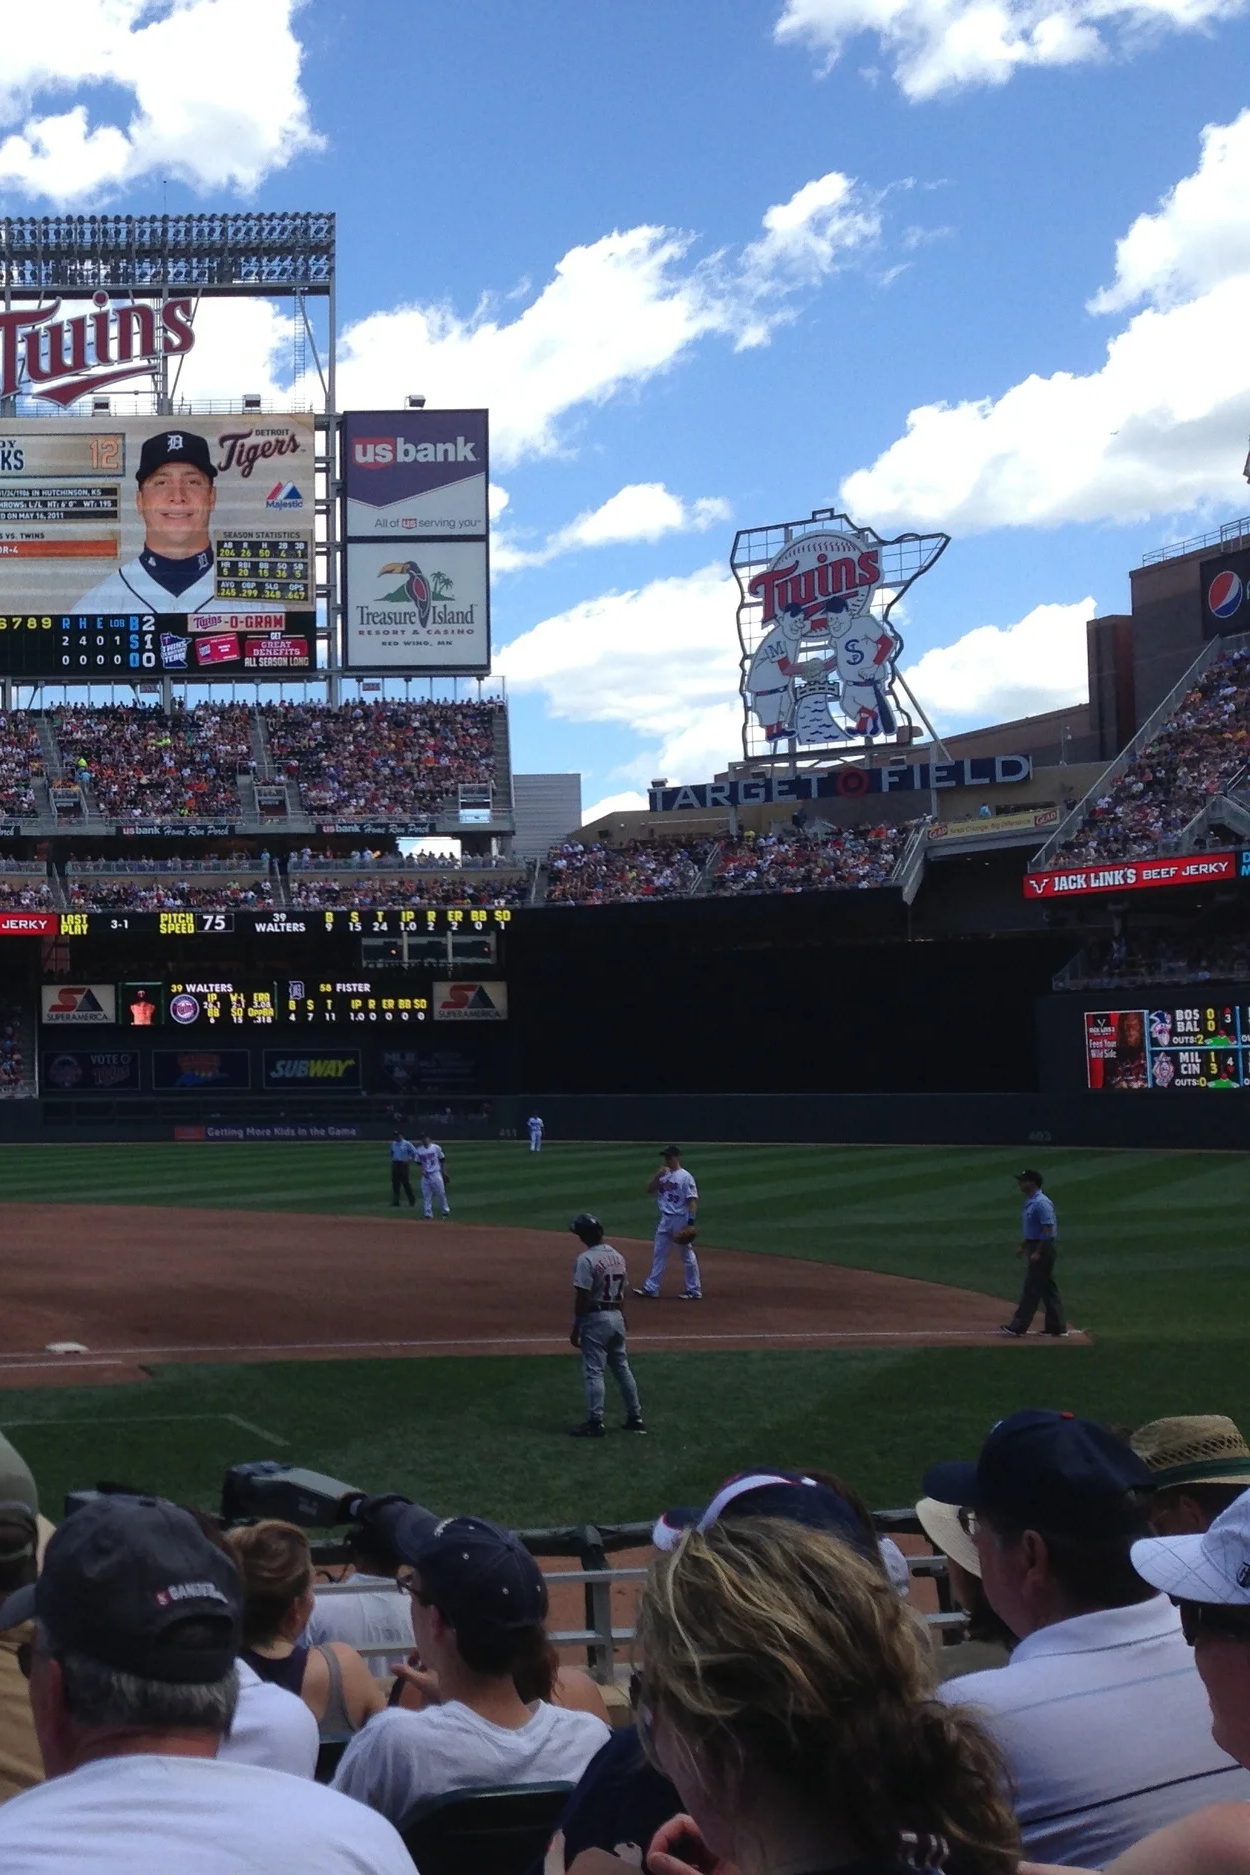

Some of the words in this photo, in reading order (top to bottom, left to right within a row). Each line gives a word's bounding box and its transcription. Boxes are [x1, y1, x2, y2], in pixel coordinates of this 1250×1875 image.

[90, 440, 118, 469] 12
[218, 428, 300, 478] Tigers
[42, 489, 90, 497] HUTCHINSON,
[266, 500, 303, 510] Majestic
[374, 519, 388, 528] All
[390, 518, 400, 528] of
[402, 520, 416, 528] us
[418, 519, 456, 530] serving
[458, 520, 477, 530] you
[747, 550, 881, 628] Twins
[356, 605, 416, 626] Treasure
[432, 605, 475, 625] Island
[271, 632, 281, 640] GET
[244, 657, 257, 667] ALL
[259, 657, 288, 666] SEASON
[289, 657, 309, 666] LONG
[651, 773, 829, 812] TARGET
[881, 755, 1031, 793] FIELD
[1054, 874, 1087, 891] JACK
[1090, 867, 1136, 887] LINK'S
[1142, 867, 1178, 880] BEEF
[1181, 861, 1229, 876] JERKY
[60, 915, 88, 924] LAST
[160, 913, 194, 923] PITCH
[202, 915, 226, 930] 75
[272, 913, 287, 922] 39
[2, 919, 47, 929] JERKY
[111, 920, 129, 929] 3-1
[160, 924, 194, 934] SPEED
[255, 923, 306, 932] WALTERS
[60, 925, 89, 935] PLAY
[171, 984, 183, 993] 39
[186, 984, 233, 992] WALTERS
[336, 983, 370, 992] FISTER
[47, 1012, 108, 1021] SUPERAMERICA
[438, 1010, 500, 1018] SUPERAMERICA
[1176, 1009, 1200, 1021] BOS
[1177, 1021, 1200, 1032] BAL
[90, 1054, 119, 1064] VOTE
[1179, 1052, 1201, 1062] MIL
[269, 1059, 355, 1078] SUBWAY
[1181, 1064, 1200, 1074] CIN
[207, 1127, 244, 1138] Getting
[247, 1128, 271, 1136] More
[274, 1127, 295, 1136] Kids
[298, 1128, 308, 1136] in
[310, 1127, 326, 1136] the
[327, 1127, 356, 1136] Game
[604, 1274, 624, 1300] 17
